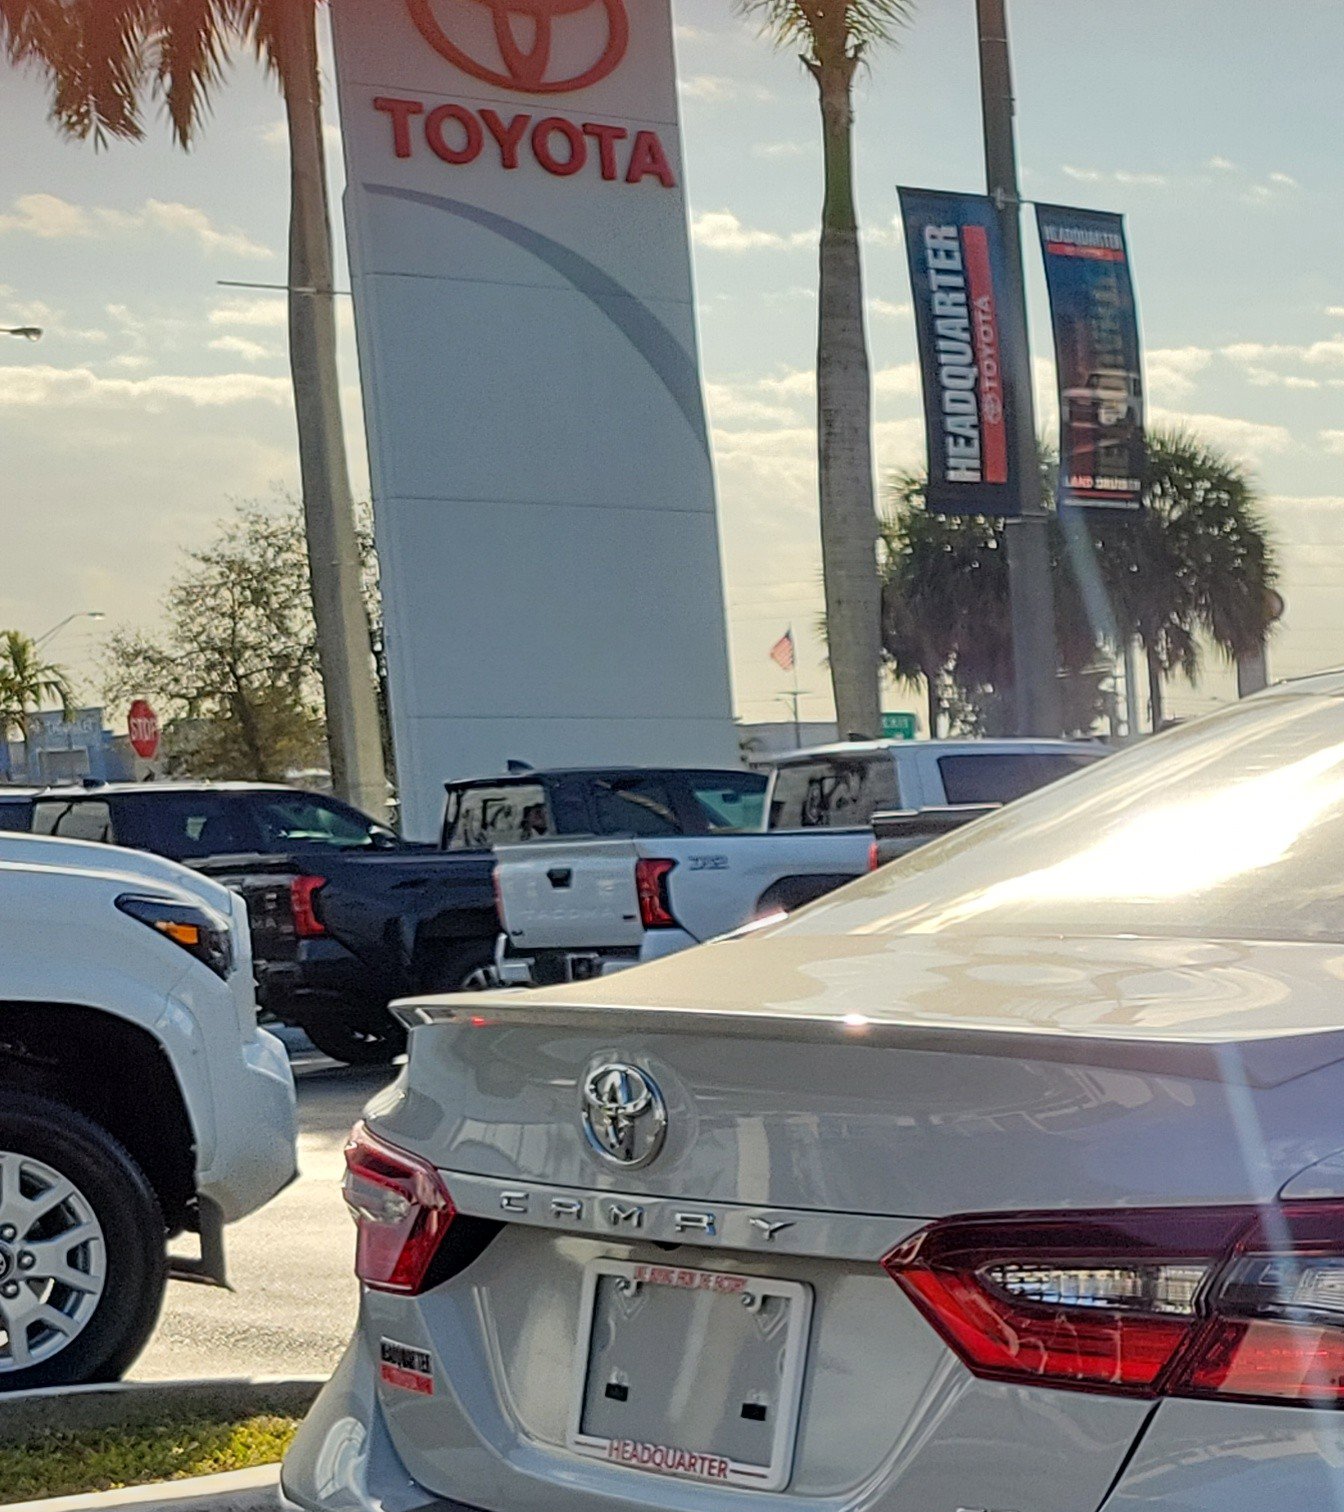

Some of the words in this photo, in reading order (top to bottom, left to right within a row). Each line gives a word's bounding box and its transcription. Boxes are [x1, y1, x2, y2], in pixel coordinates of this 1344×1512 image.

[373, 96, 676, 188] TOYOTA
[924, 224, 982, 483] HEADQUARTER
[973, 295, 999, 388] TOYOTA
[130, 718, 158, 741] STOP
[500, 1192, 796, 1242] CAMRY
[607, 1439, 729, 1479] HEADQUARTER
